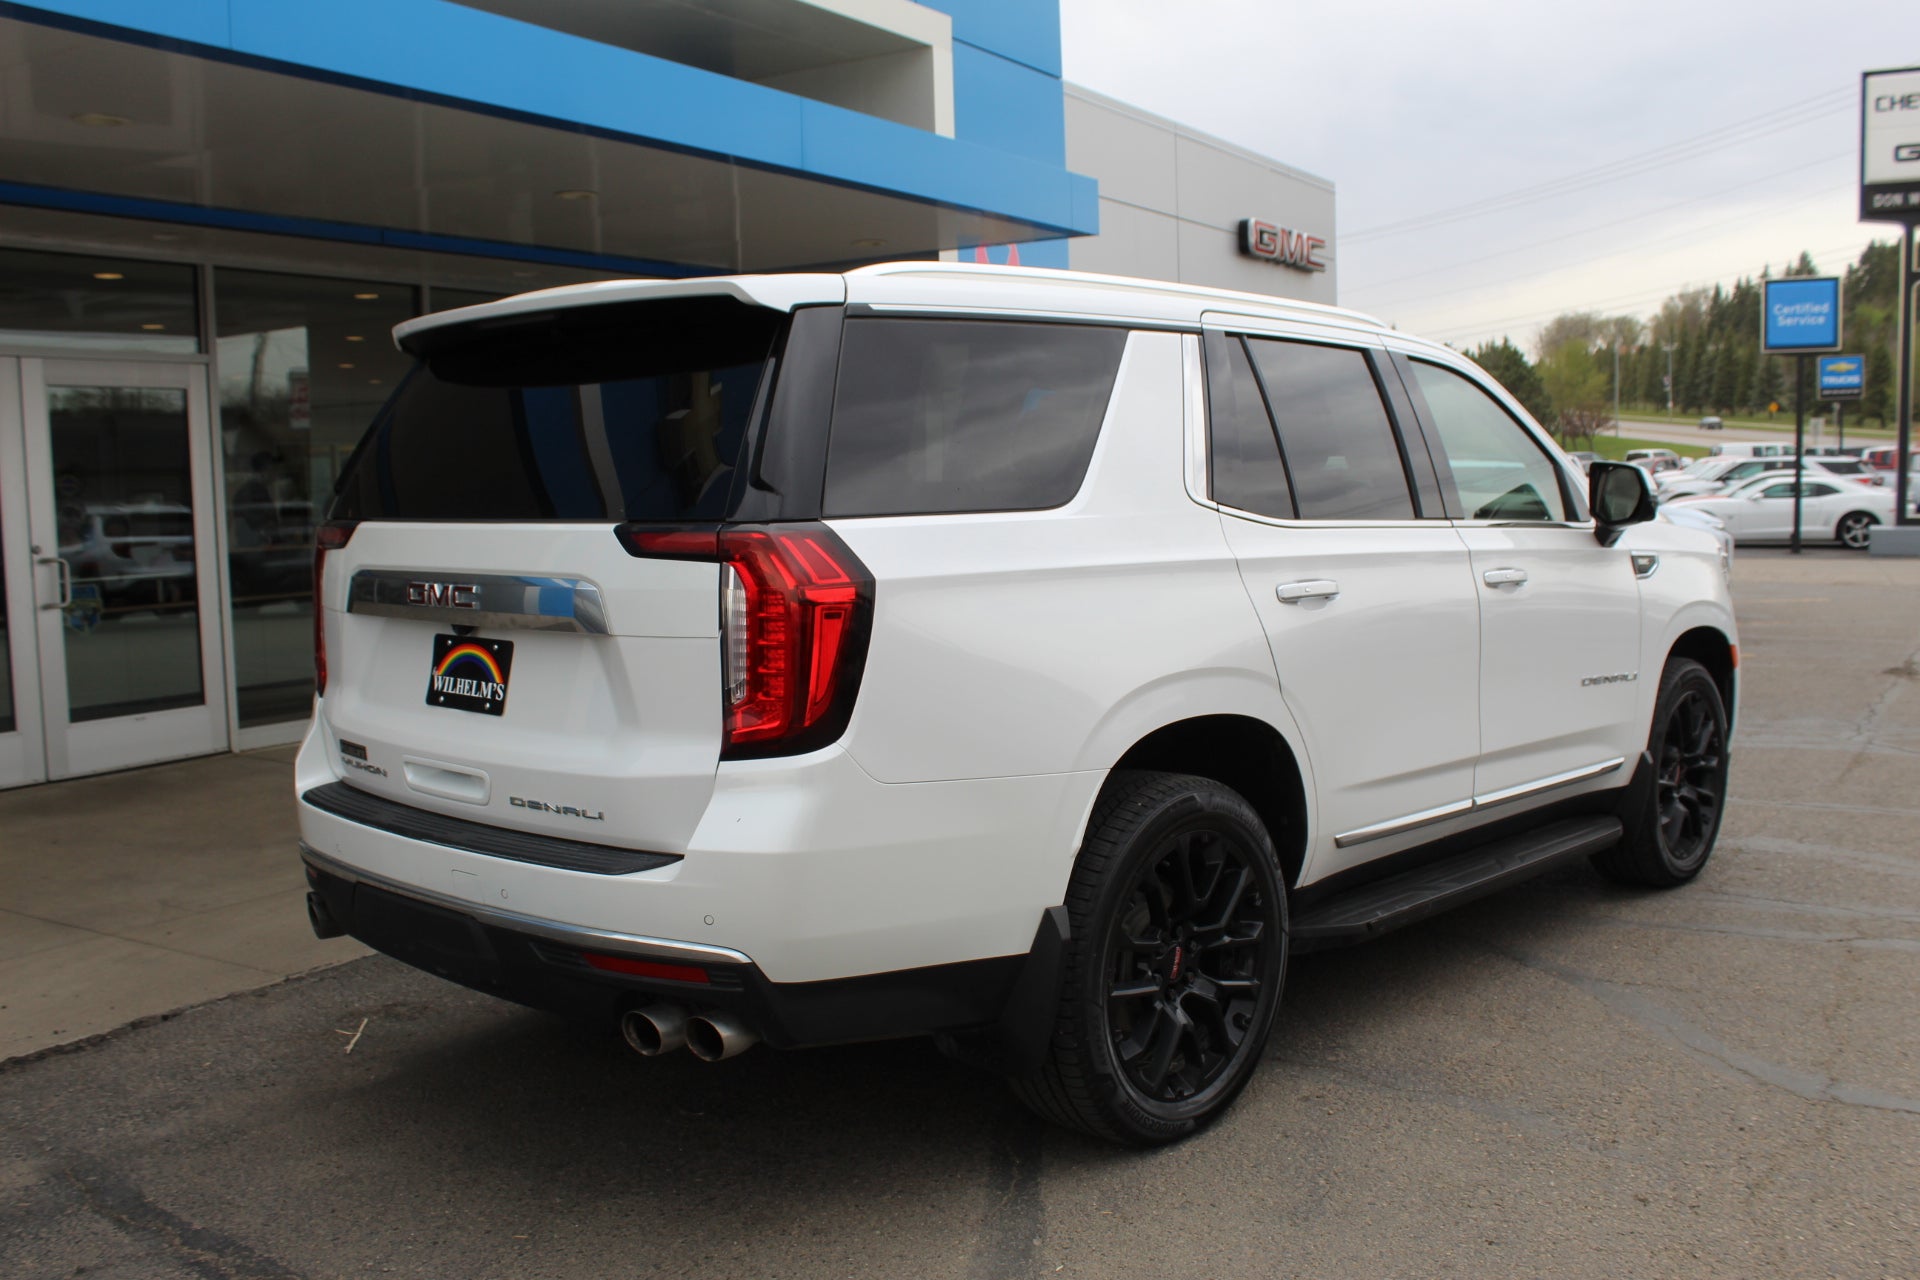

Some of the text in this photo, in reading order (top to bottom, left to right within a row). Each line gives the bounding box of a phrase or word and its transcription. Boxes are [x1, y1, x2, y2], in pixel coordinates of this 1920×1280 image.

[1248, 217, 1326, 272] GMC
[1773, 303, 1830, 315] Certified
[1777, 315, 1826, 327] Service
[1822, 375, 1861, 385] TRUCKS
[407, 581, 480, 609] GMC
[433, 674, 505, 701] WILHELM'S
[1581, 672, 1638, 687] DENALI
[509, 796, 605, 821] DENALI
